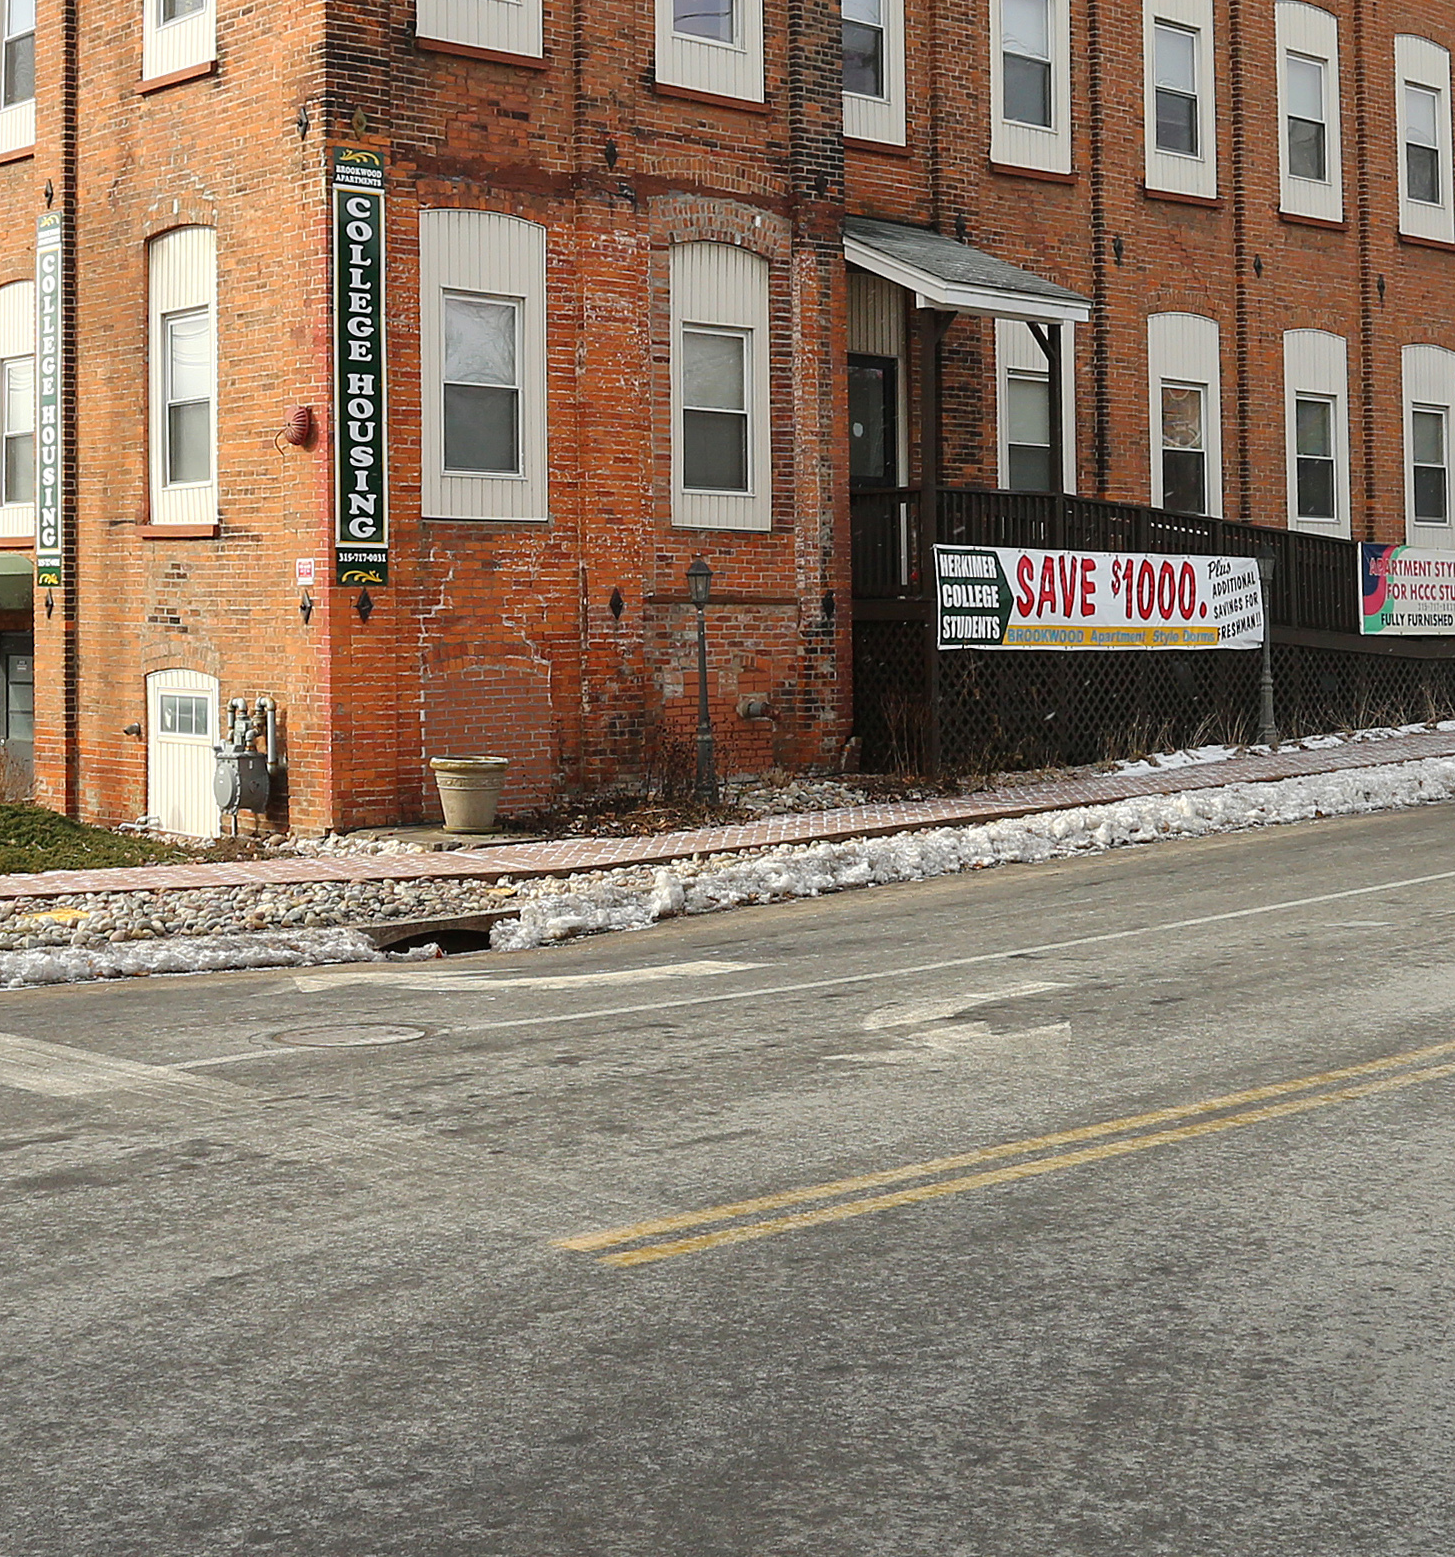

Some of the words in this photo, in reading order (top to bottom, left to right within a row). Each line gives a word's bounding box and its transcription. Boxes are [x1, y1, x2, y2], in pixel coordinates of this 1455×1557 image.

[346, 196, 375, 363] COLLEGE
[41, 253, 56, 396] COLLEGE
[346, 373, 377, 539] HOUSING
[41, 405, 57, 547] HOUSING
[338, 553, 387, 563] 315-717-0031
[939, 554, 997, 578] HERKIMER
[1208, 559, 1232, 580] Plus
[1369, 557, 1432, 577] APARTMENT
[942, 584, 1000, 608] COLLEGE
[1016, 554, 1096, 618] SAVE
[1111, 558, 1208, 621] $1000.
[1212, 571, 1256, 599] ADDITIONAL
[1387, 584, 1407, 600] FOR
[1410, 584, 1437, 601] HCCC
[1213, 598, 1244, 620] SAVINGS
[1245, 591, 1259, 608] FOR
[942, 615, 1000, 639] STUDENTS
[1217, 611, 1263, 641] FRESHMAN!!
[1381, 614, 1405, 626] FULLY
[1407, 614, 1454, 626] FURNISHED
[1007, 629, 1084, 642] BROOKWOOD
[1091, 630, 1146, 644] Apartment
[1153, 630, 1179, 645] Style
[1182, 630, 1215, 642] Dorms
